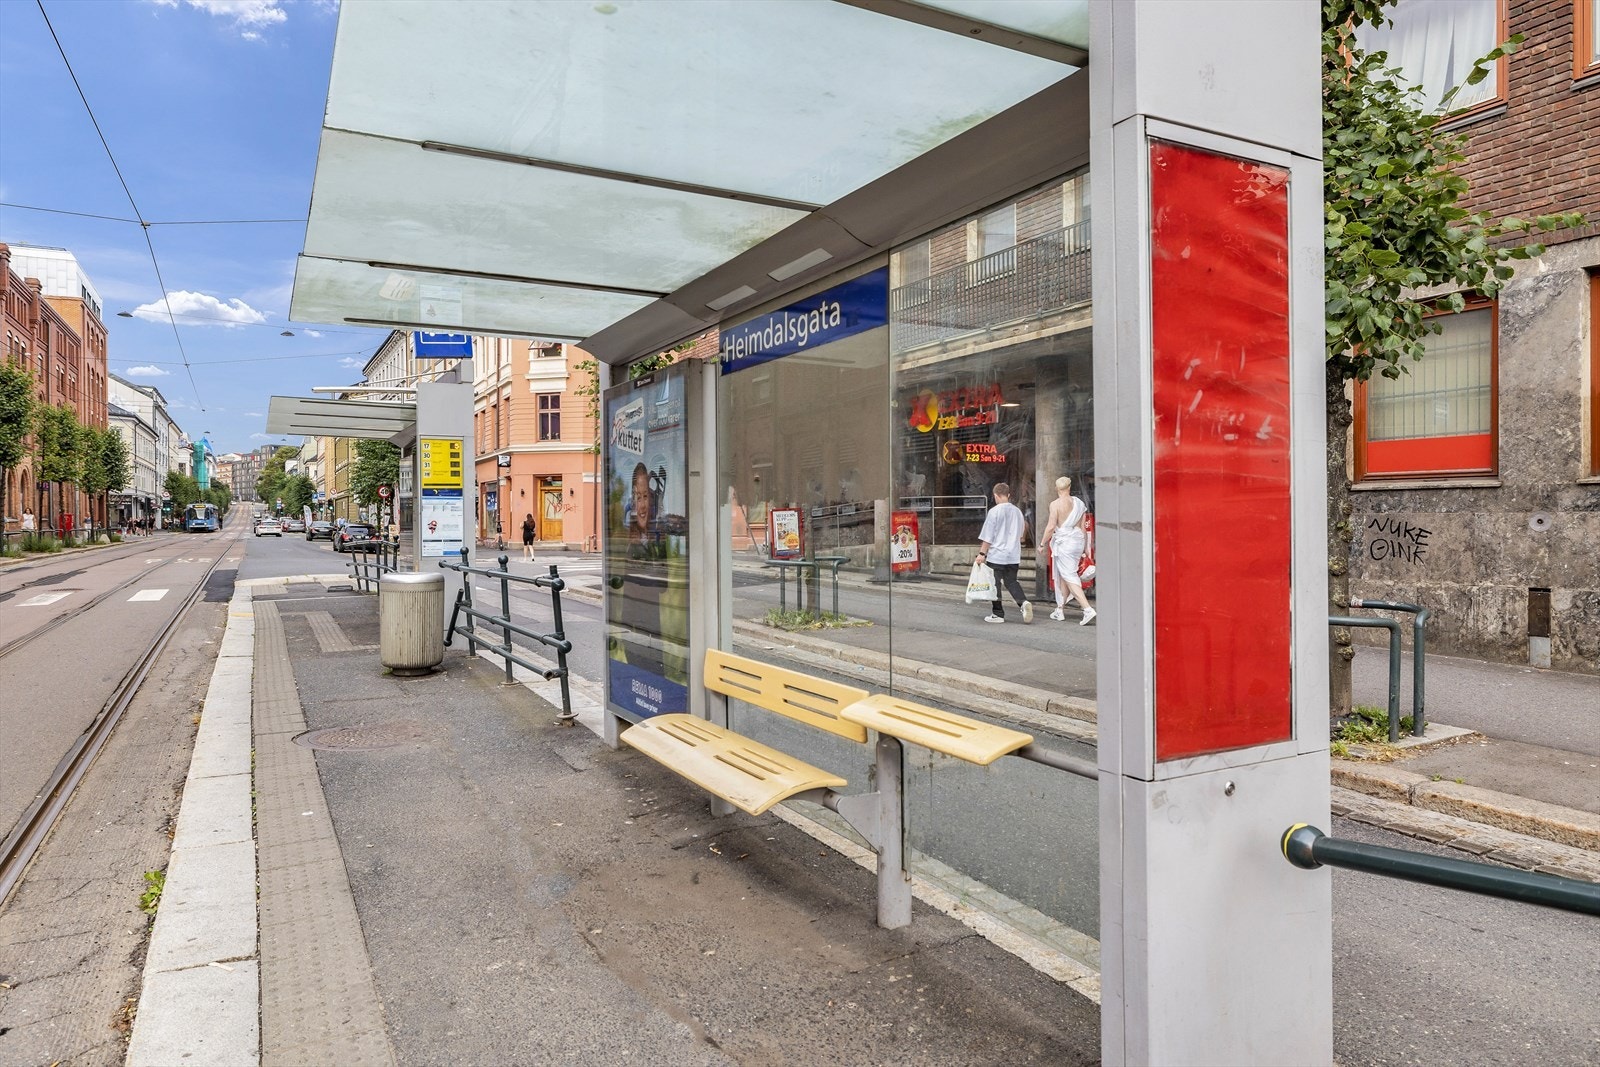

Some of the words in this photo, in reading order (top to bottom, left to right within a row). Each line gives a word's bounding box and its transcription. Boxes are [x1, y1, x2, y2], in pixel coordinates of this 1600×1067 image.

[725, 301, 841, 362] Heimdalsgata
[618, 431, 642, 452] kuttet
[966, 444, 997, 453] EXTRA
[966, 453, 980, 462] 7-23
[992, 454, 1005, 462] 9-21
[1368, 517, 1432, 546] NUKE
[898, 549, 913, 559] -20%
[1370, 539, 1426, 566] OINK
[632, 679, 647, 697] REMA
[648, 686, 662, 703] 1000
